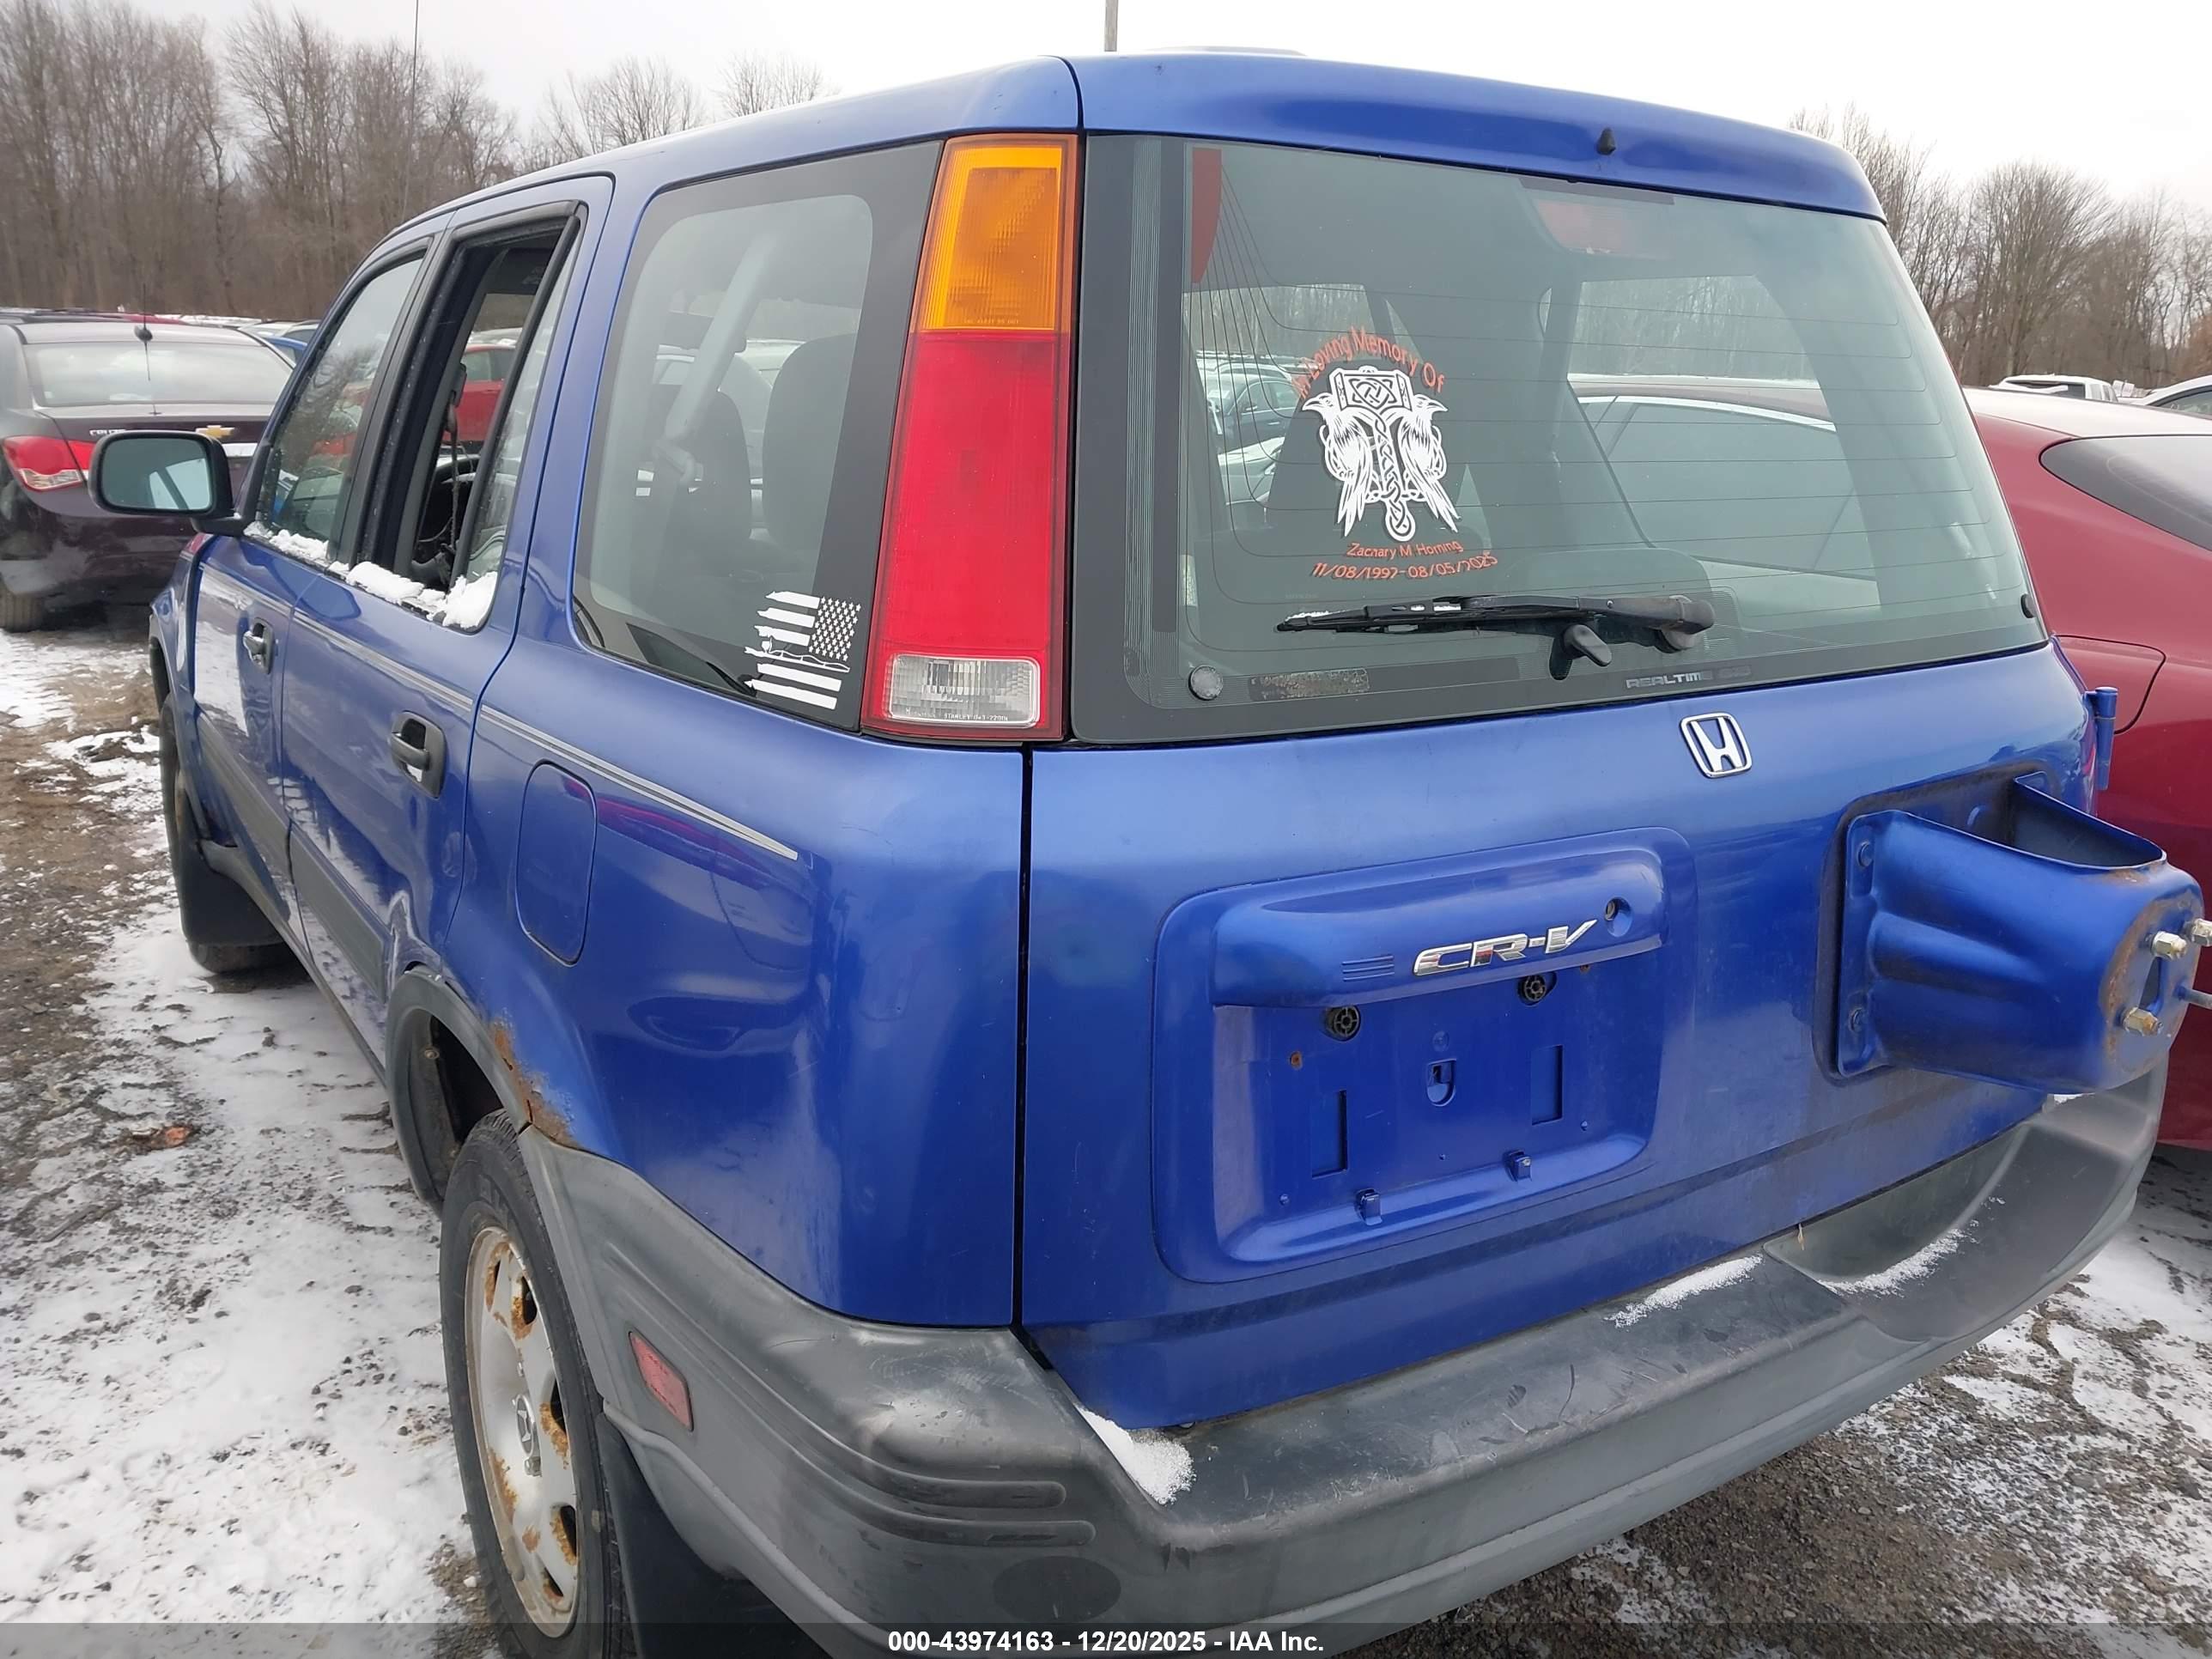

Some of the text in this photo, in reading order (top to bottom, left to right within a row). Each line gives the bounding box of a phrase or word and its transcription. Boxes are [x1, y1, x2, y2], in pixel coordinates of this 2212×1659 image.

[1351, 325, 1419, 377] Memory
[1423, 362, 1445, 393] Of
[1400, 544, 1413, 557] M
[1413, 919, 1598, 976] CR-V
